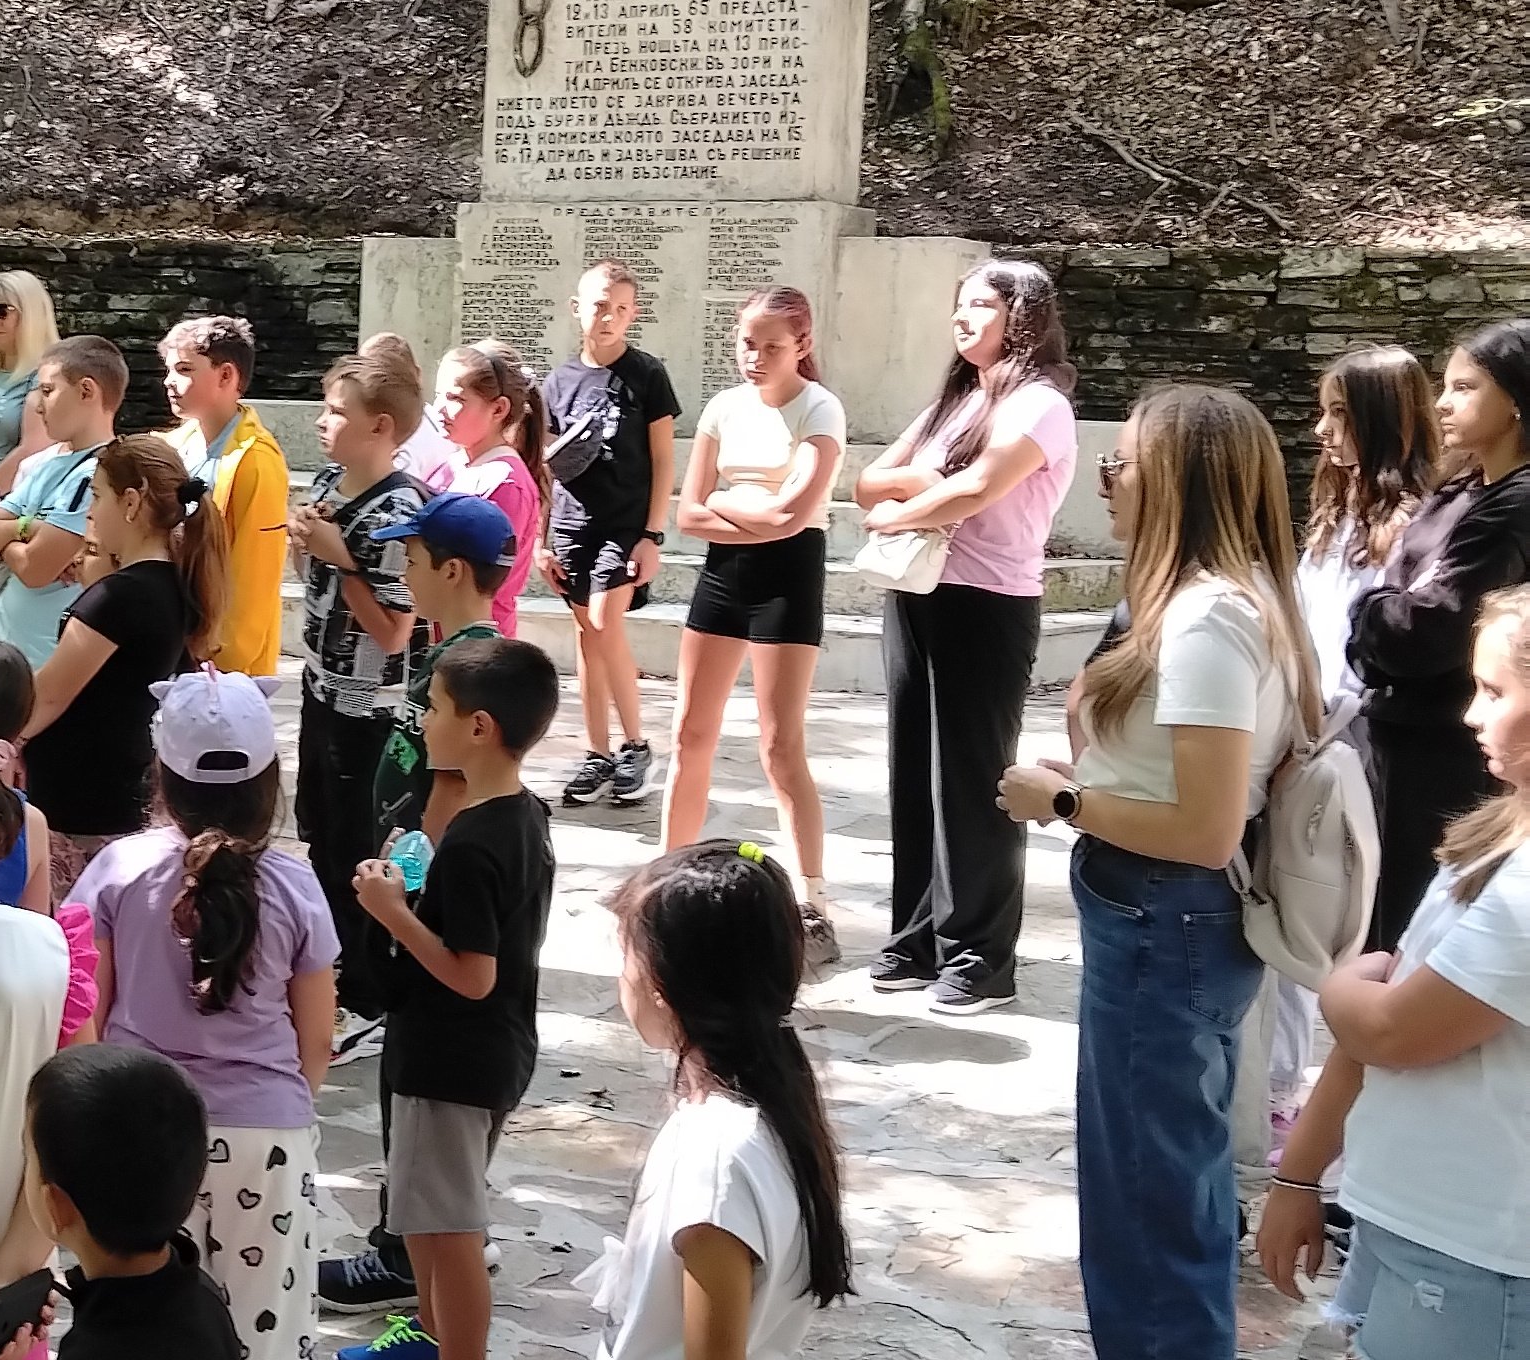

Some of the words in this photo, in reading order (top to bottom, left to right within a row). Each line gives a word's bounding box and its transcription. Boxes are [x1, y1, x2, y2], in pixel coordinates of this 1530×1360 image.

[688, 0, 710, 15] 65
[566, 23, 627, 38] ВИТЕЛИ
[637, 22, 658, 36] НА
[672, 19, 692, 34] 58
[708, 39, 730, 52] НА
[734, 34, 750, 51] 13
[565, 60, 603, 74] ТИГА
[730, 55, 771, 69] ЗОРИ
[781, 55, 804, 68] НА
[644, 76, 662, 90] СЕ
[666, 75, 735, 89] ОТКРИВА
[549, 96, 597, 110] КОЕТО
[606, 95, 624, 108] СЕ
[634, 94, 708, 108] ЗАКРИВА
[614, 130, 663, 143] КОЯТО
[671, 129, 755, 143] ЗАСЕДАВА
[761, 128, 780, 142] НА
[731, 147, 801, 160] РЕШЕНИЕ
[545, 167, 567, 182] ДА
[574, 166, 623, 180] ОБЯВИ
